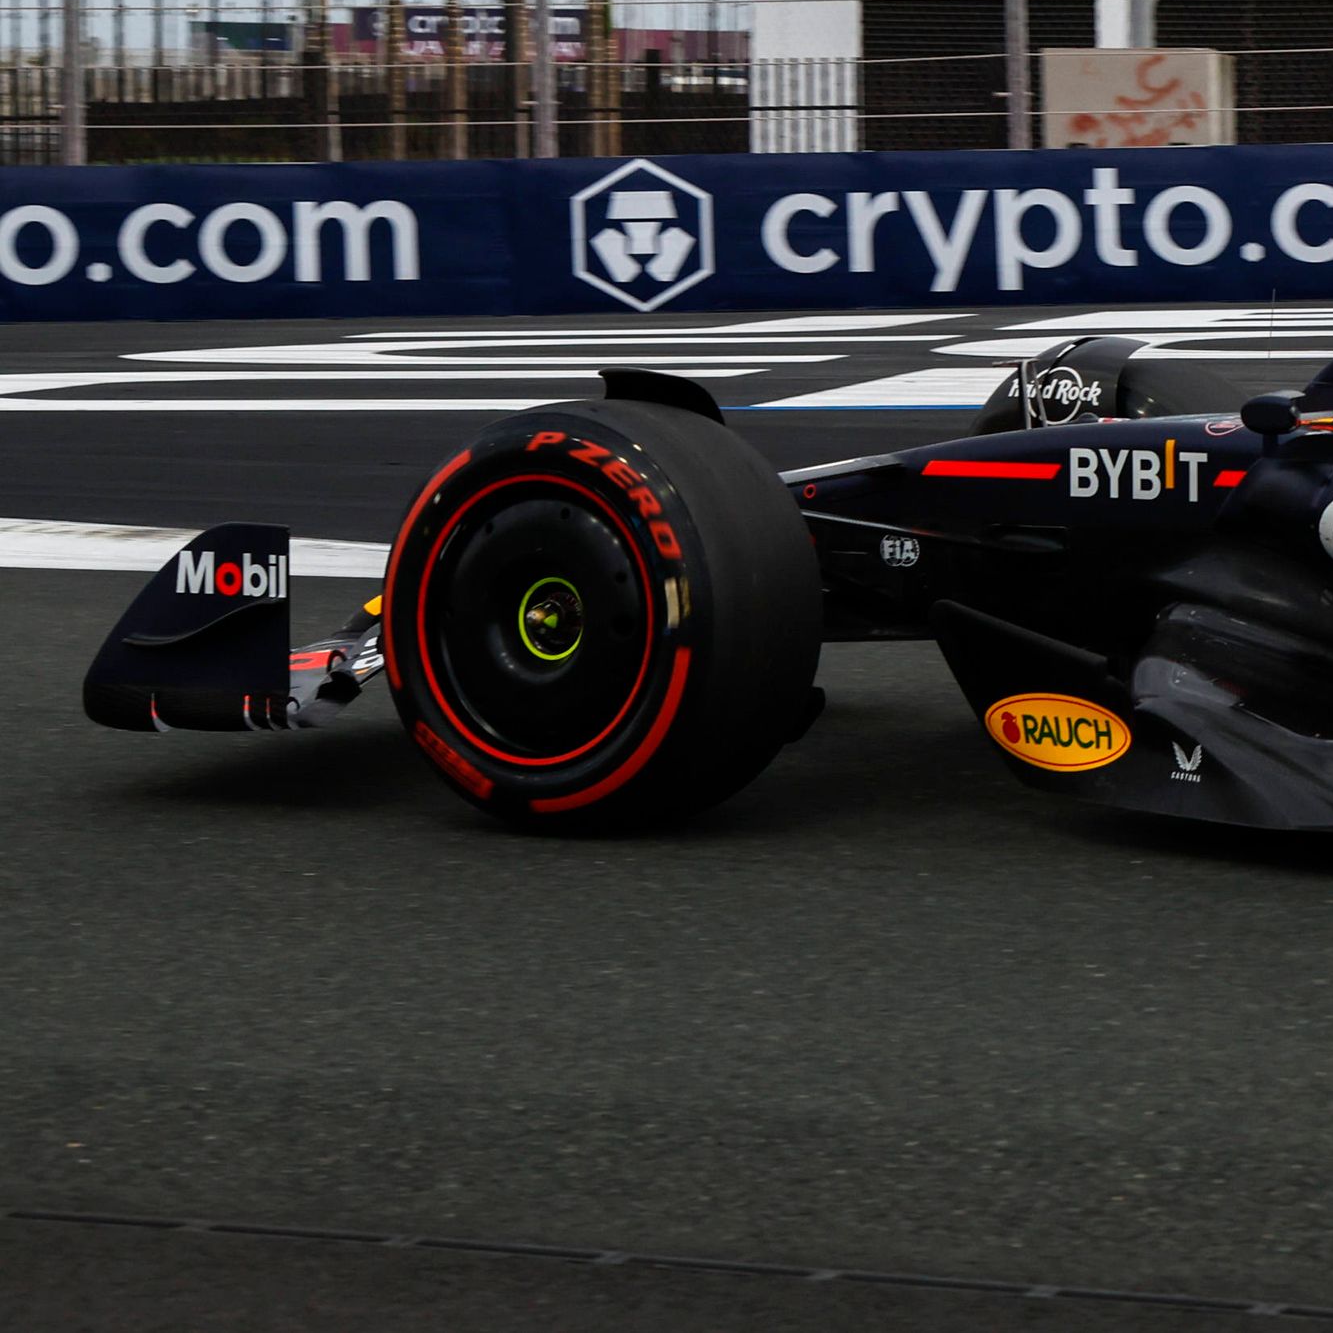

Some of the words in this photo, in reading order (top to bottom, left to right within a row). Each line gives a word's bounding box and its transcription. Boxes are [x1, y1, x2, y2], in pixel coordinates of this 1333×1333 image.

[1007, 378, 1059, 399] Had
[1055, 379, 1102, 406] Rock
[525, 431, 567, 452] P
[568, 440, 682, 559] ZERO
[1069, 439, 1209, 503] BYBIT
[176, 550, 288, 599] Mobil
[1022, 714, 1112, 750] RAUCH
